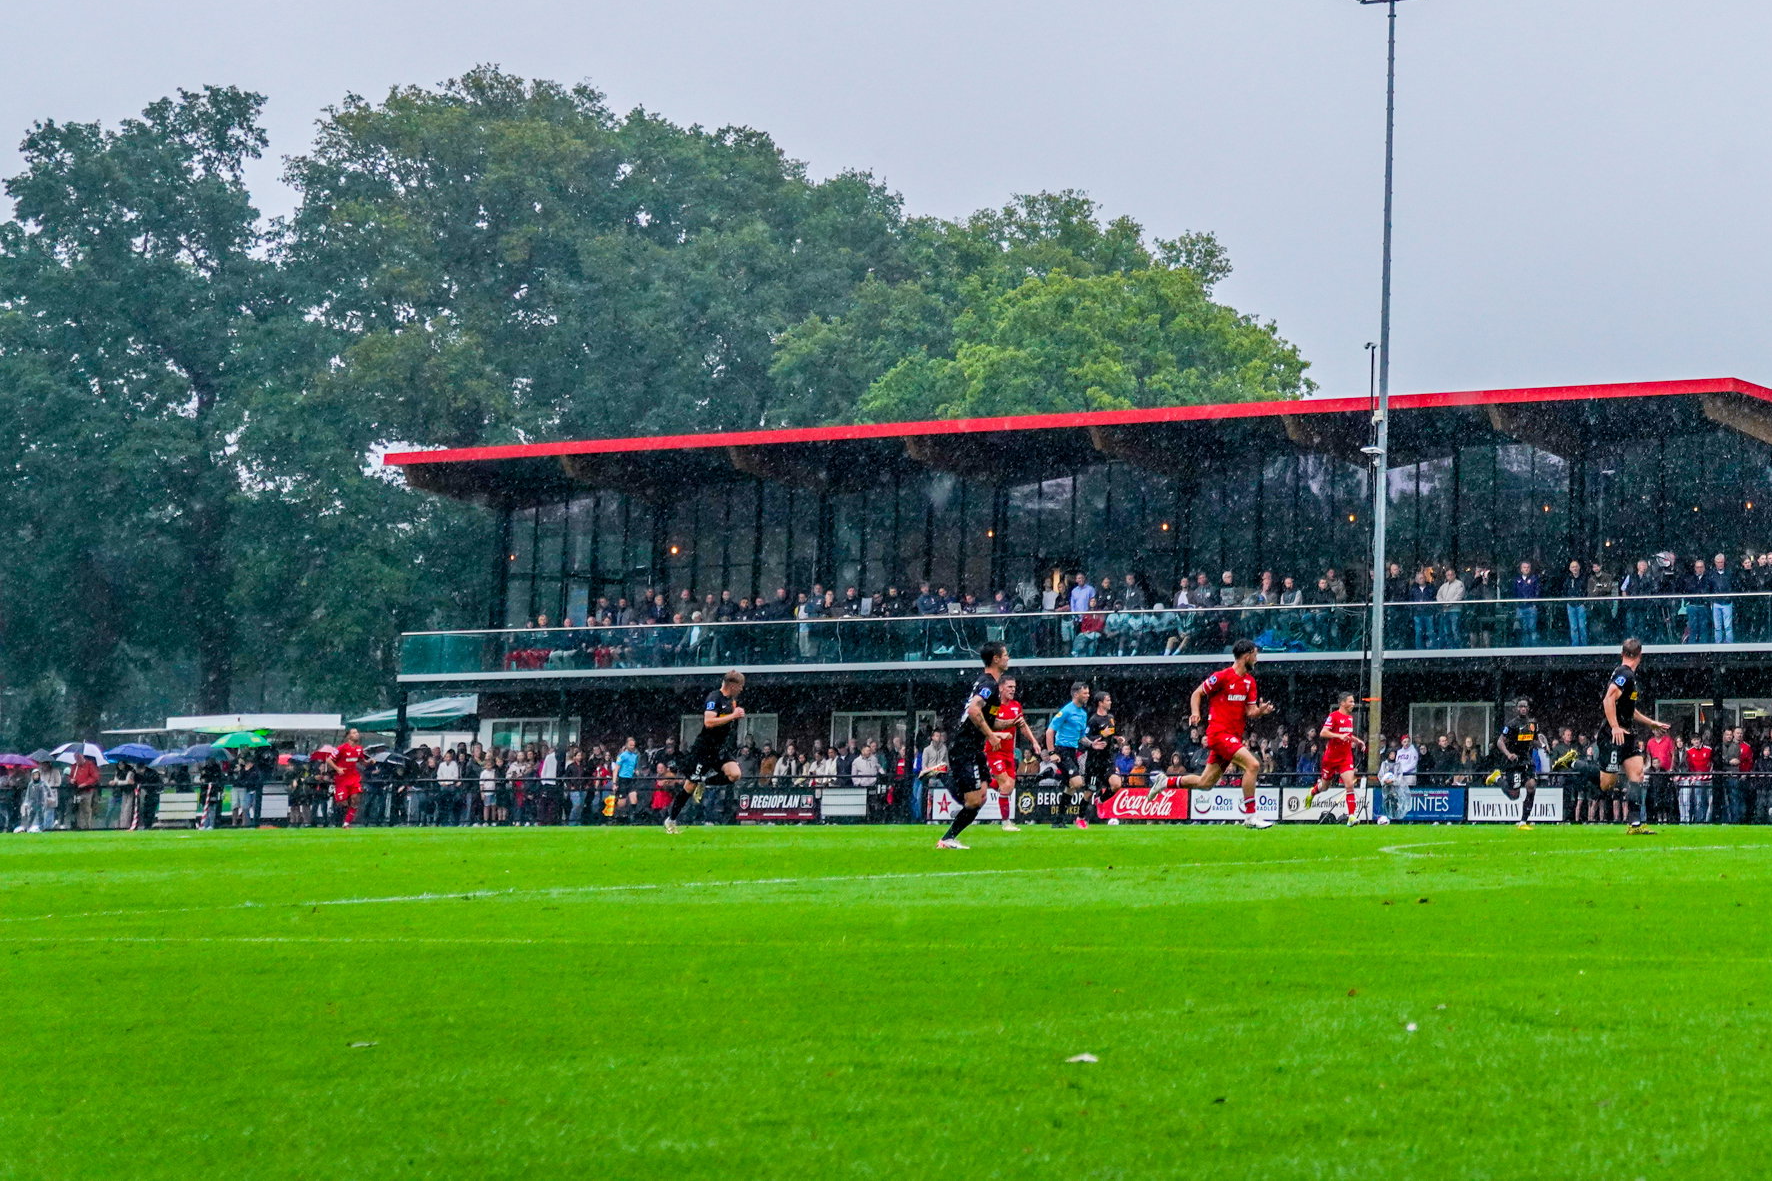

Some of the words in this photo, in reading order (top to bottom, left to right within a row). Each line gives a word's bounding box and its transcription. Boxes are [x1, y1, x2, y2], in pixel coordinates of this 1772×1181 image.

[1610, 750, 1617, 764] 6
[750, 794, 800, 809] REGIOPLAN
[1112, 789, 1176, 816] Coca-Cola
[1406, 796, 1449, 812] UINTES
[1473, 800, 1502, 817] WAPEN
[1505, 803, 1520, 817] VAN
[1531, 803, 1556, 817] LDEN
